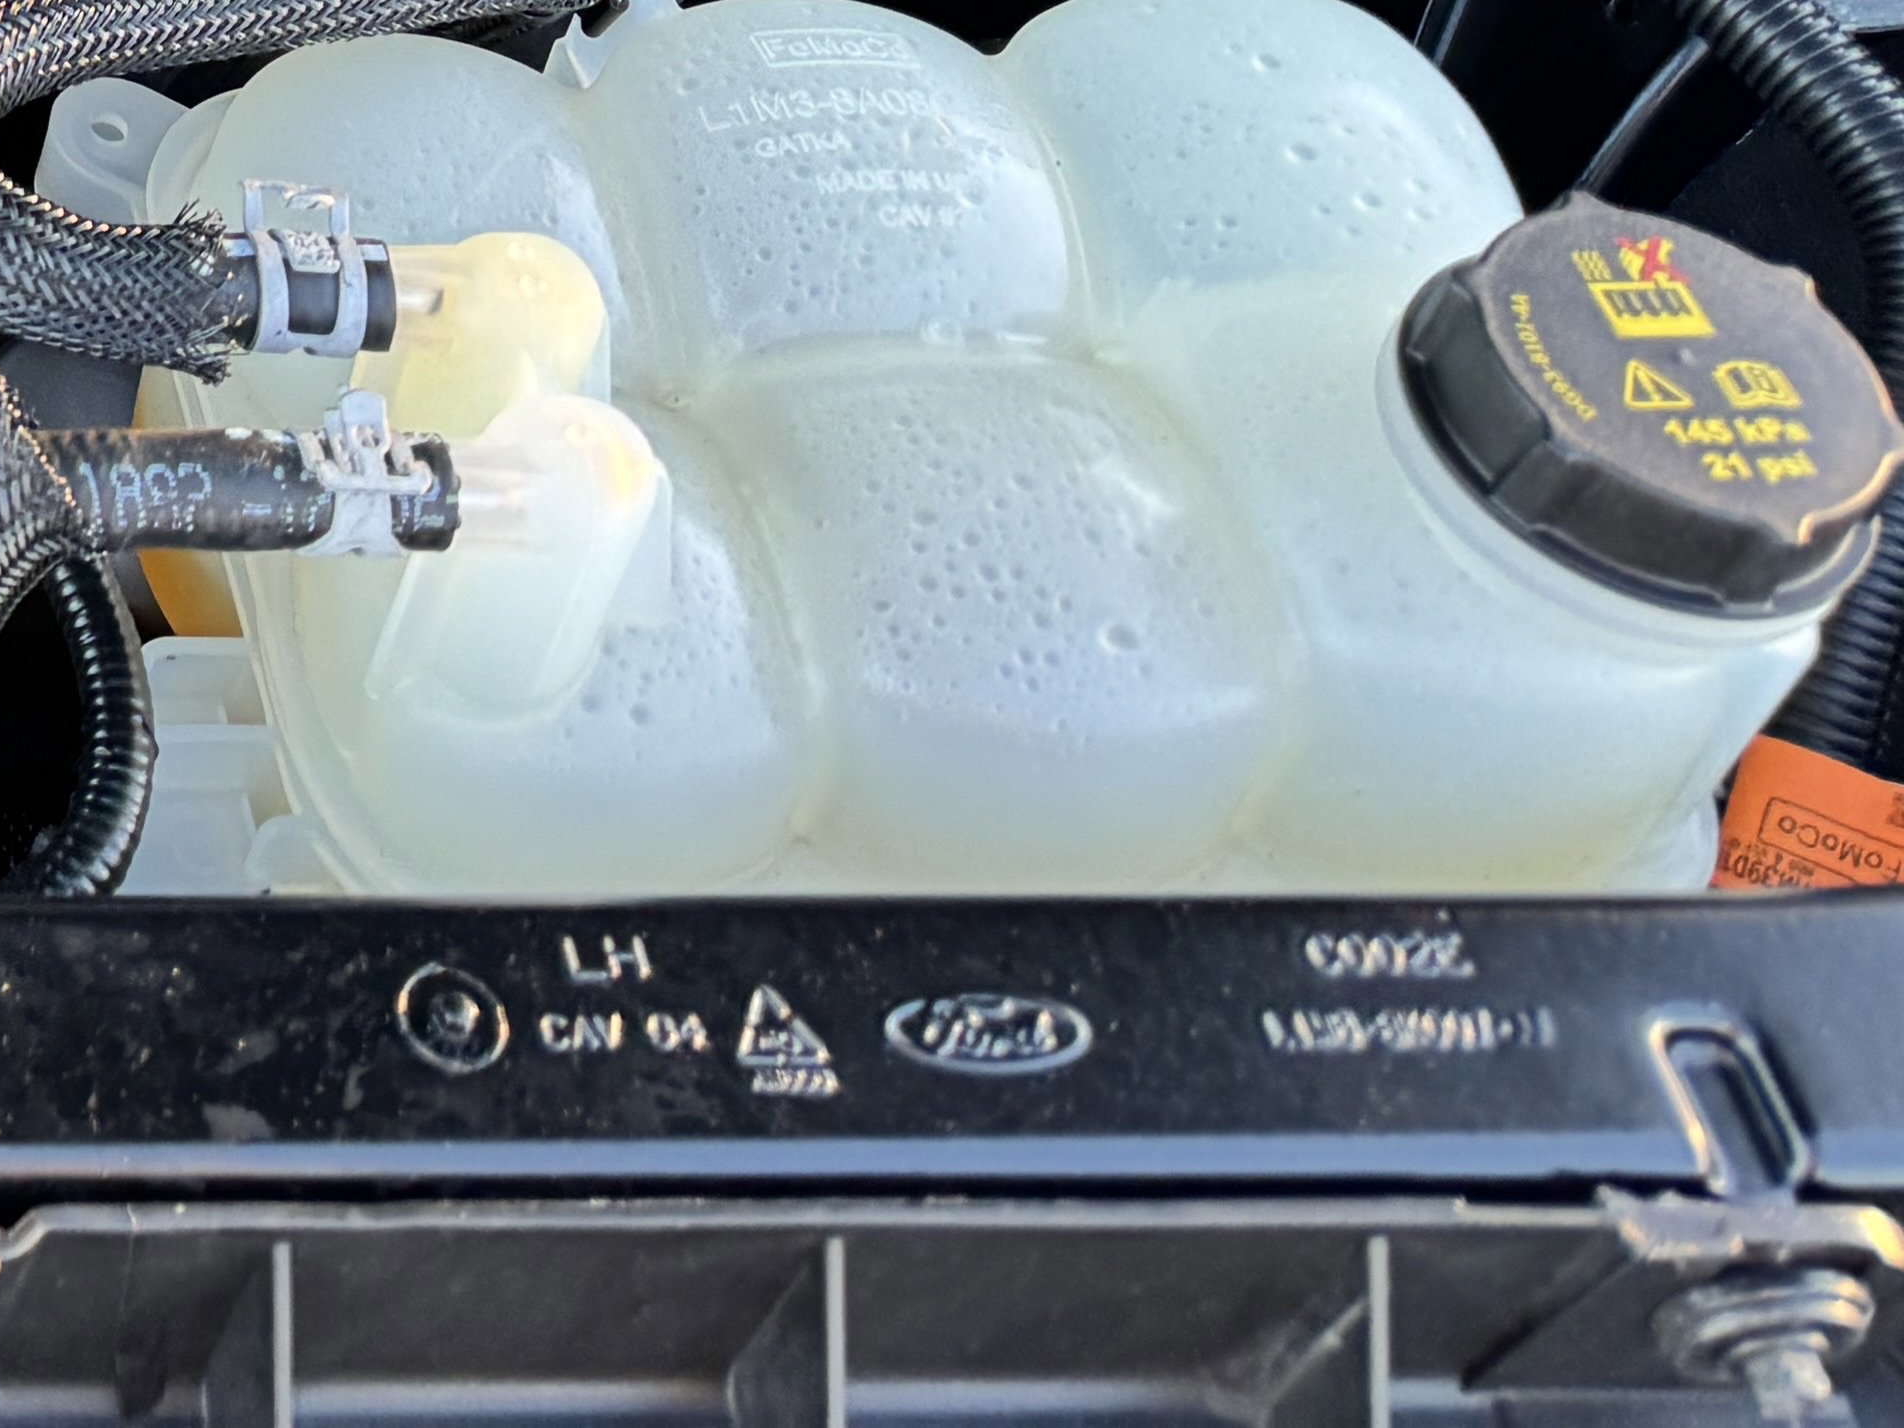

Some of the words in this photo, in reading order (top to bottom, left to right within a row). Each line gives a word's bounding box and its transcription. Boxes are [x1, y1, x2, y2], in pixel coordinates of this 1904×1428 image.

[761, 34, 914, 61] FoMoCo
[816, 169, 898, 195] MADE
[1663, 417, 1733, 445] 145
[1733, 415, 1812, 444] kPa
[1700, 452, 1753, 482] 21
[1756, 448, 1818, 485] psi
[1777, 815, 1902, 883] FoMoCo
[562, 934, 653, 983] LH
[539, 1010, 623, 1052] CAV
